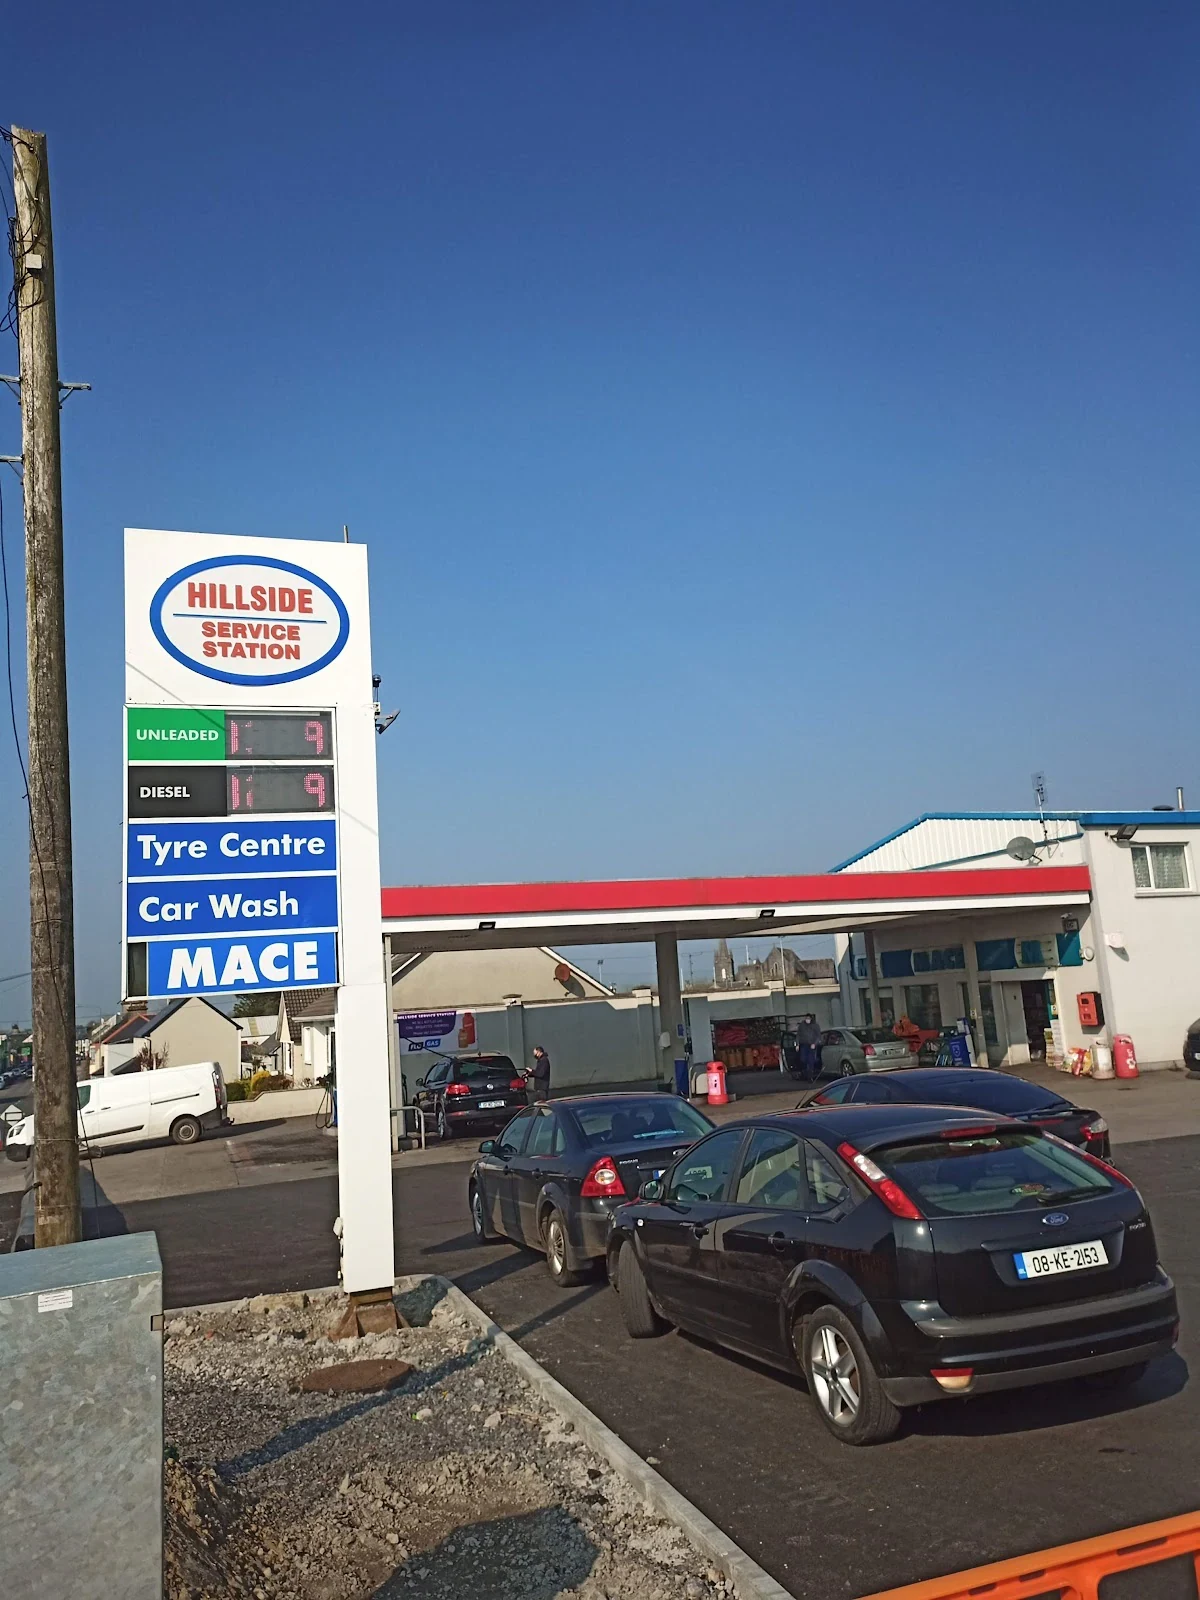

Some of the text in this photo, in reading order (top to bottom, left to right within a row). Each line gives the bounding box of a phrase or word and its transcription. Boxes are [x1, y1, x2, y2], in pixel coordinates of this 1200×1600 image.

[187, 582, 314, 614] HILLSIDE
[202, 621, 301, 641] SERVICE
[202, 641, 301, 660] STATION
[136, 729, 219, 741] UNLEADED
[139, 786, 191, 799] DIESEL
[137, 832, 326, 866] Tyre Centre
[138, 890, 299, 923] Car Wash
[166, 940, 319, 989] MACE
[1032, 1246, 1099, 1274] 08-KE-2153
